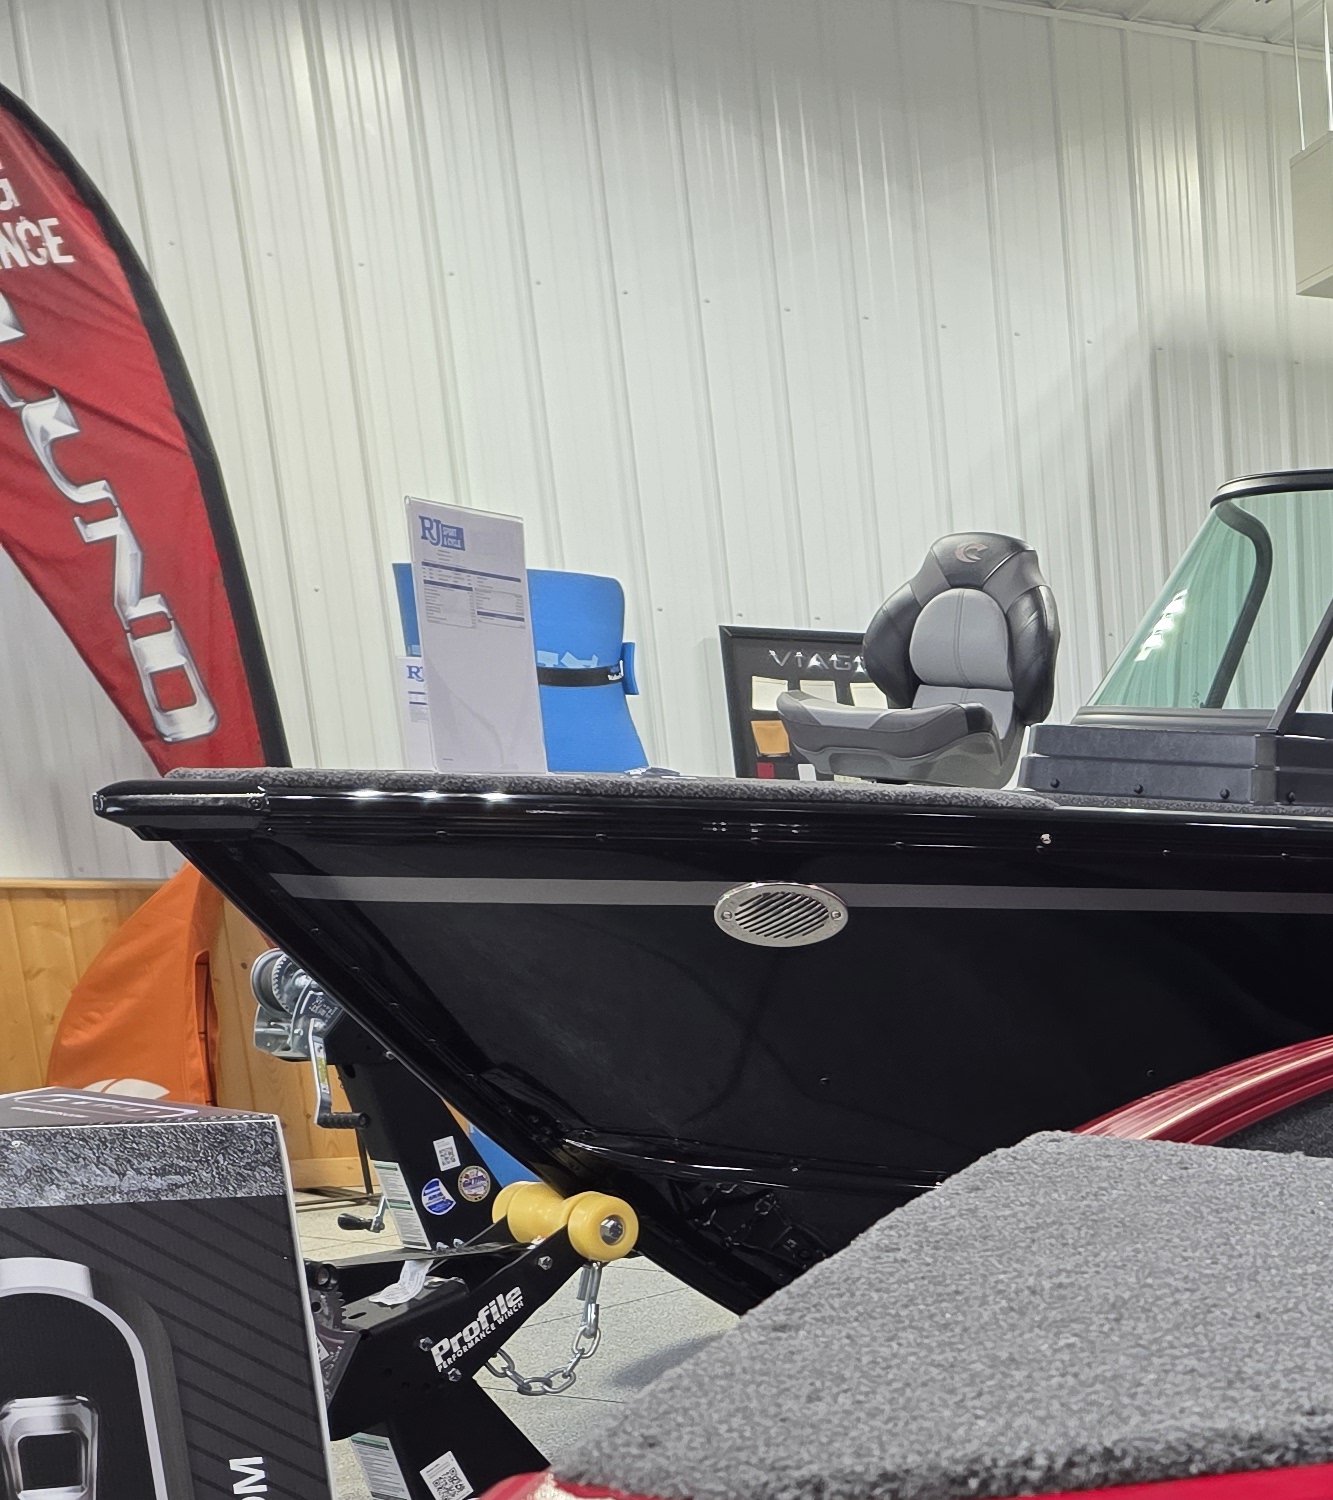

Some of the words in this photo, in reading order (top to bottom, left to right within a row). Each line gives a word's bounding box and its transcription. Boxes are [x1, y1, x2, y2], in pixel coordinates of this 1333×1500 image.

[430, 1286, 522, 1367] Profile
[437, 1322, 497, 1373] PERFORMANCE
[496, 1300, 525, 1325] WINCH
